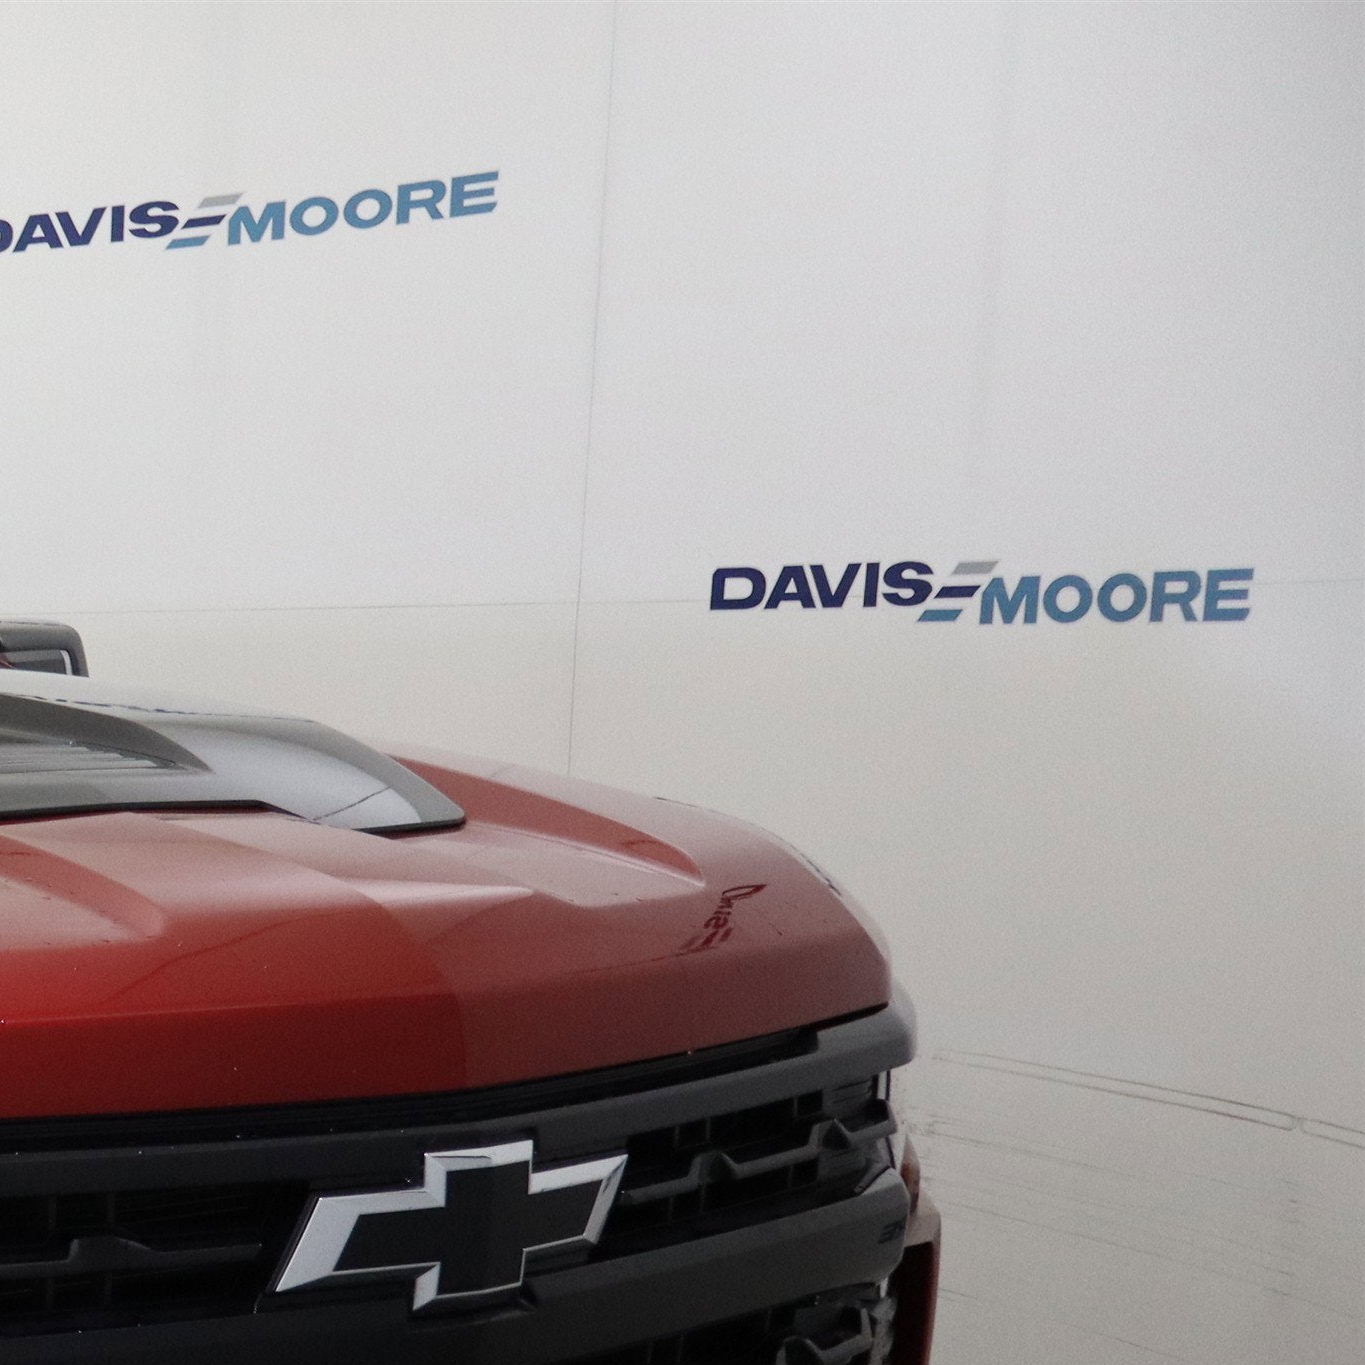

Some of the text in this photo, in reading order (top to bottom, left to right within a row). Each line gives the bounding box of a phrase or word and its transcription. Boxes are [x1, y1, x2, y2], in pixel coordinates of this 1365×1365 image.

[226, 170, 500, 246] MOORE
[709, 560, 1256, 626] DAVIS MOORE
